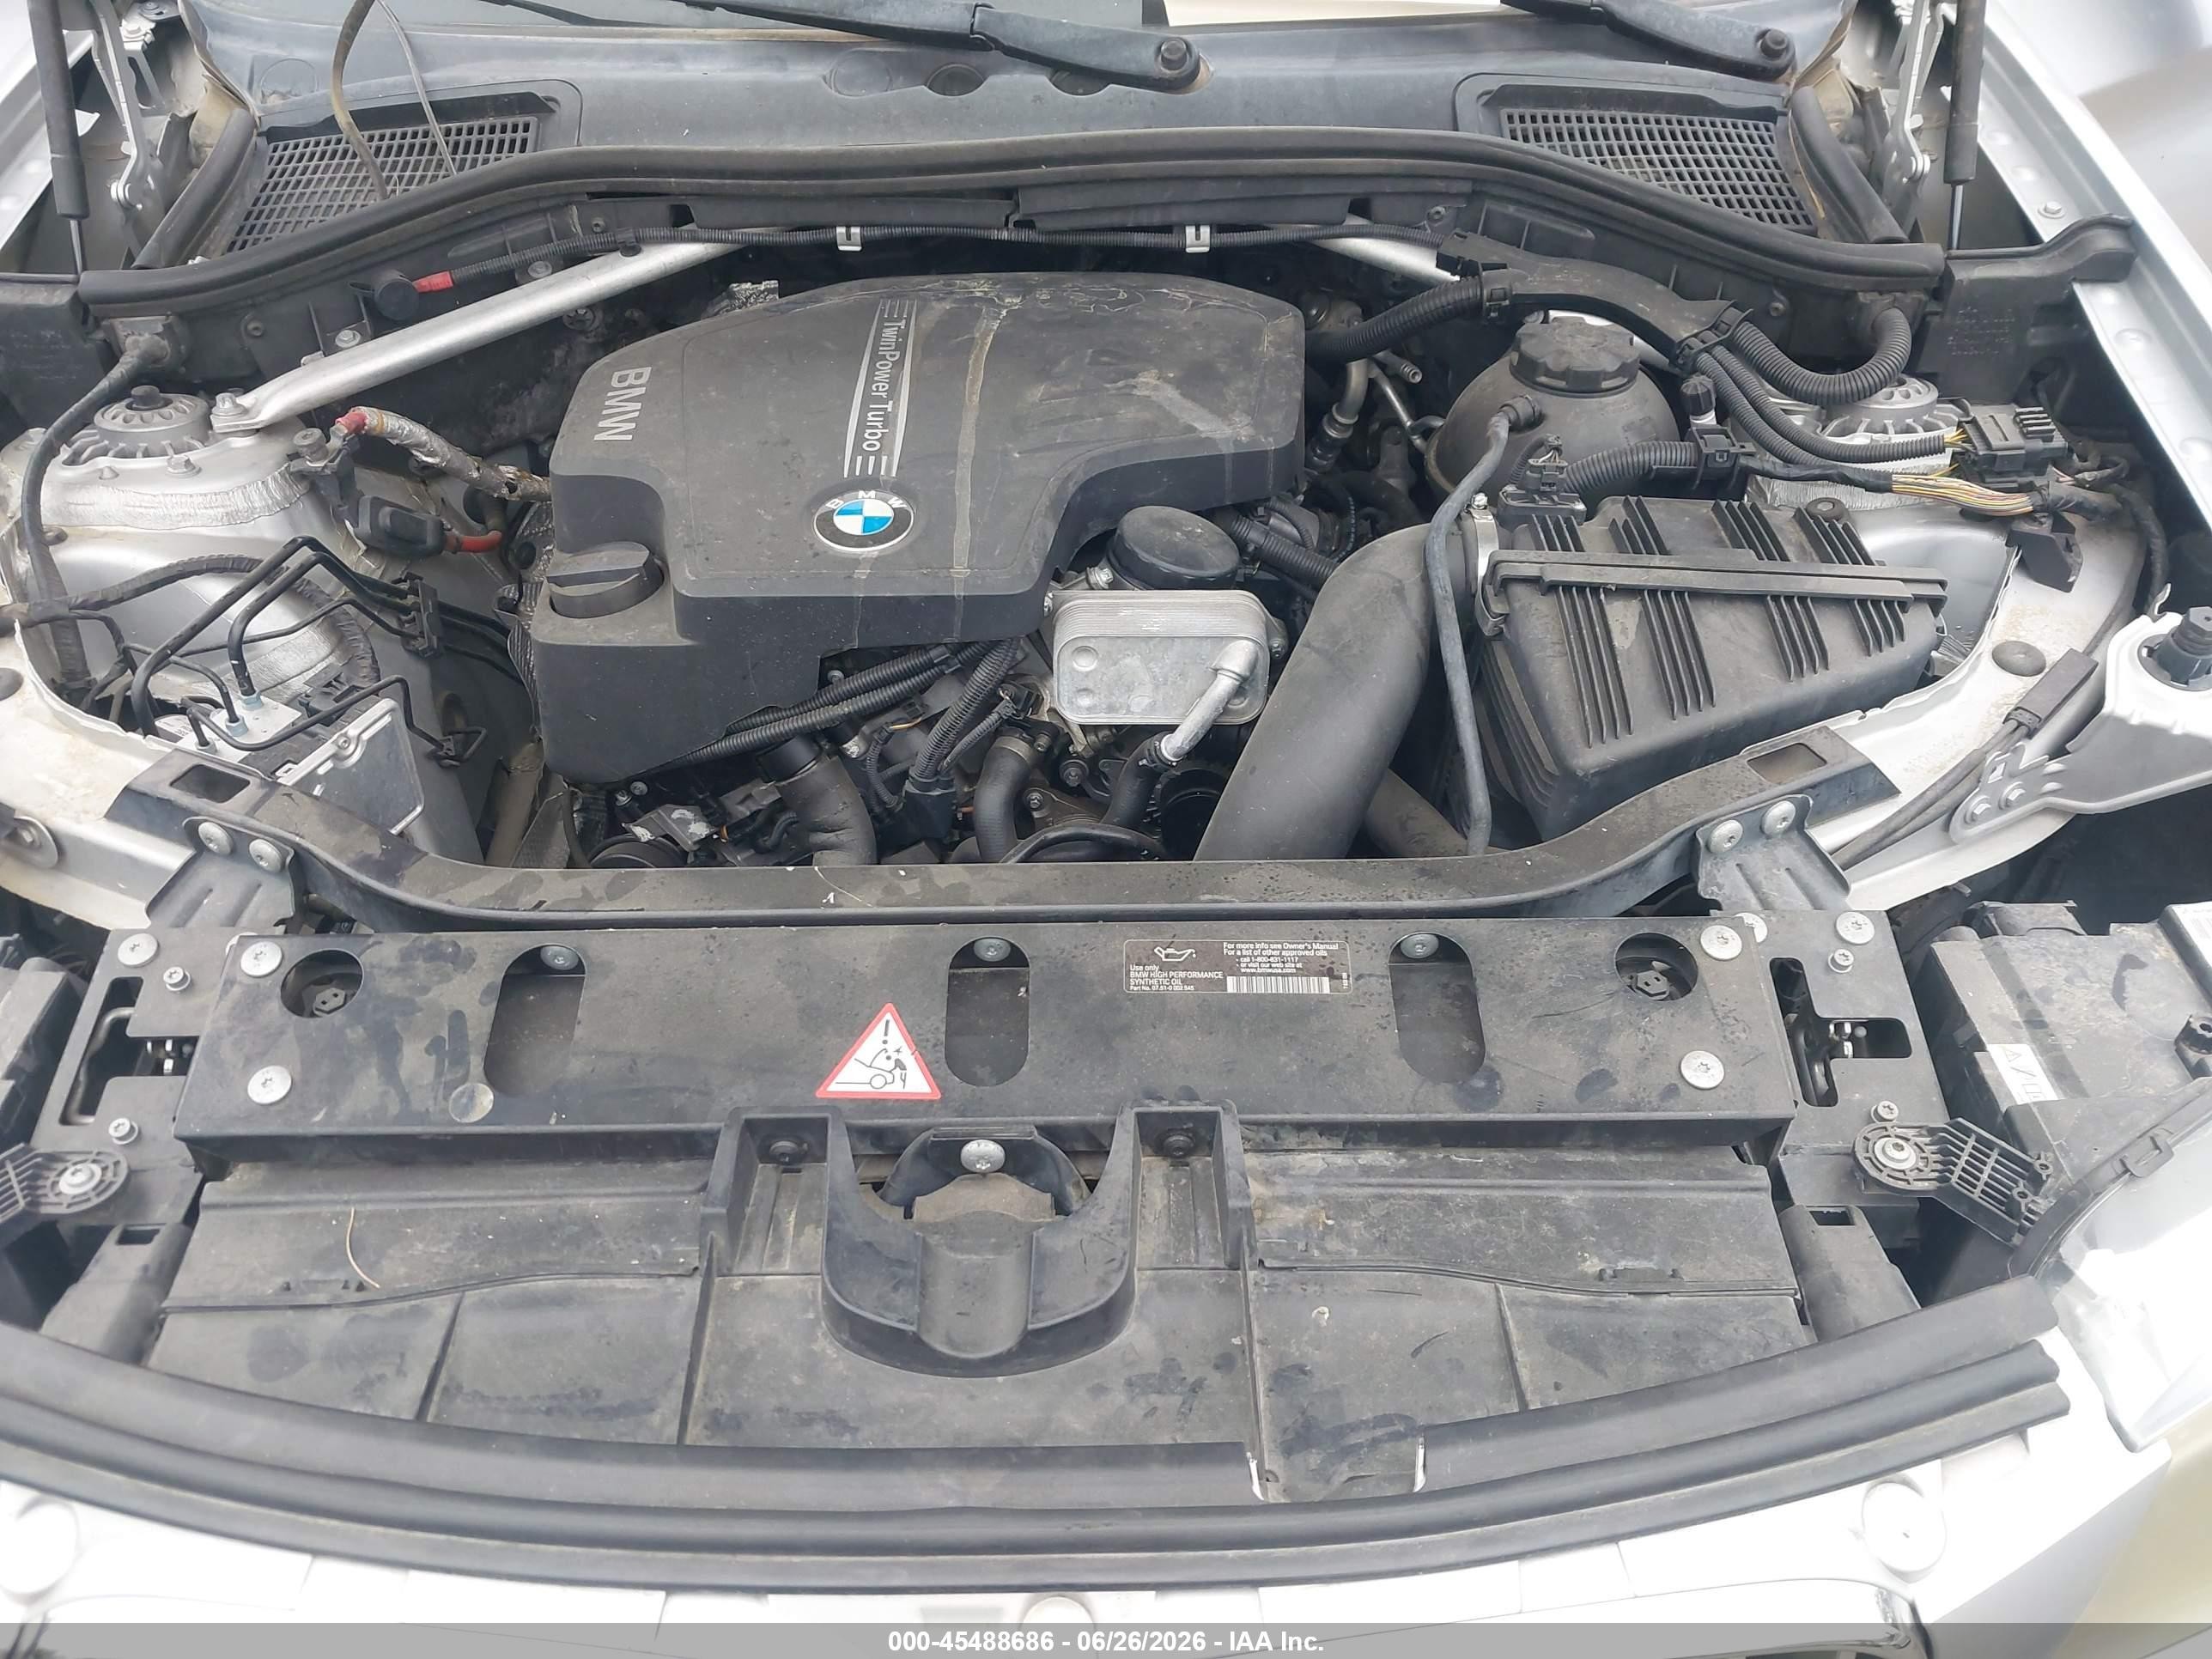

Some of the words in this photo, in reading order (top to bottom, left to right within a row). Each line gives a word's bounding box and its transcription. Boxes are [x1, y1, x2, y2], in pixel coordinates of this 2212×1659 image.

[871, 319, 907, 398] TwinPower
[593, 367, 652, 441] BMW
[862, 400, 893, 452] Turbo
[825, 490, 908, 509] BMW
[1145, 964, 1159, 973] only
